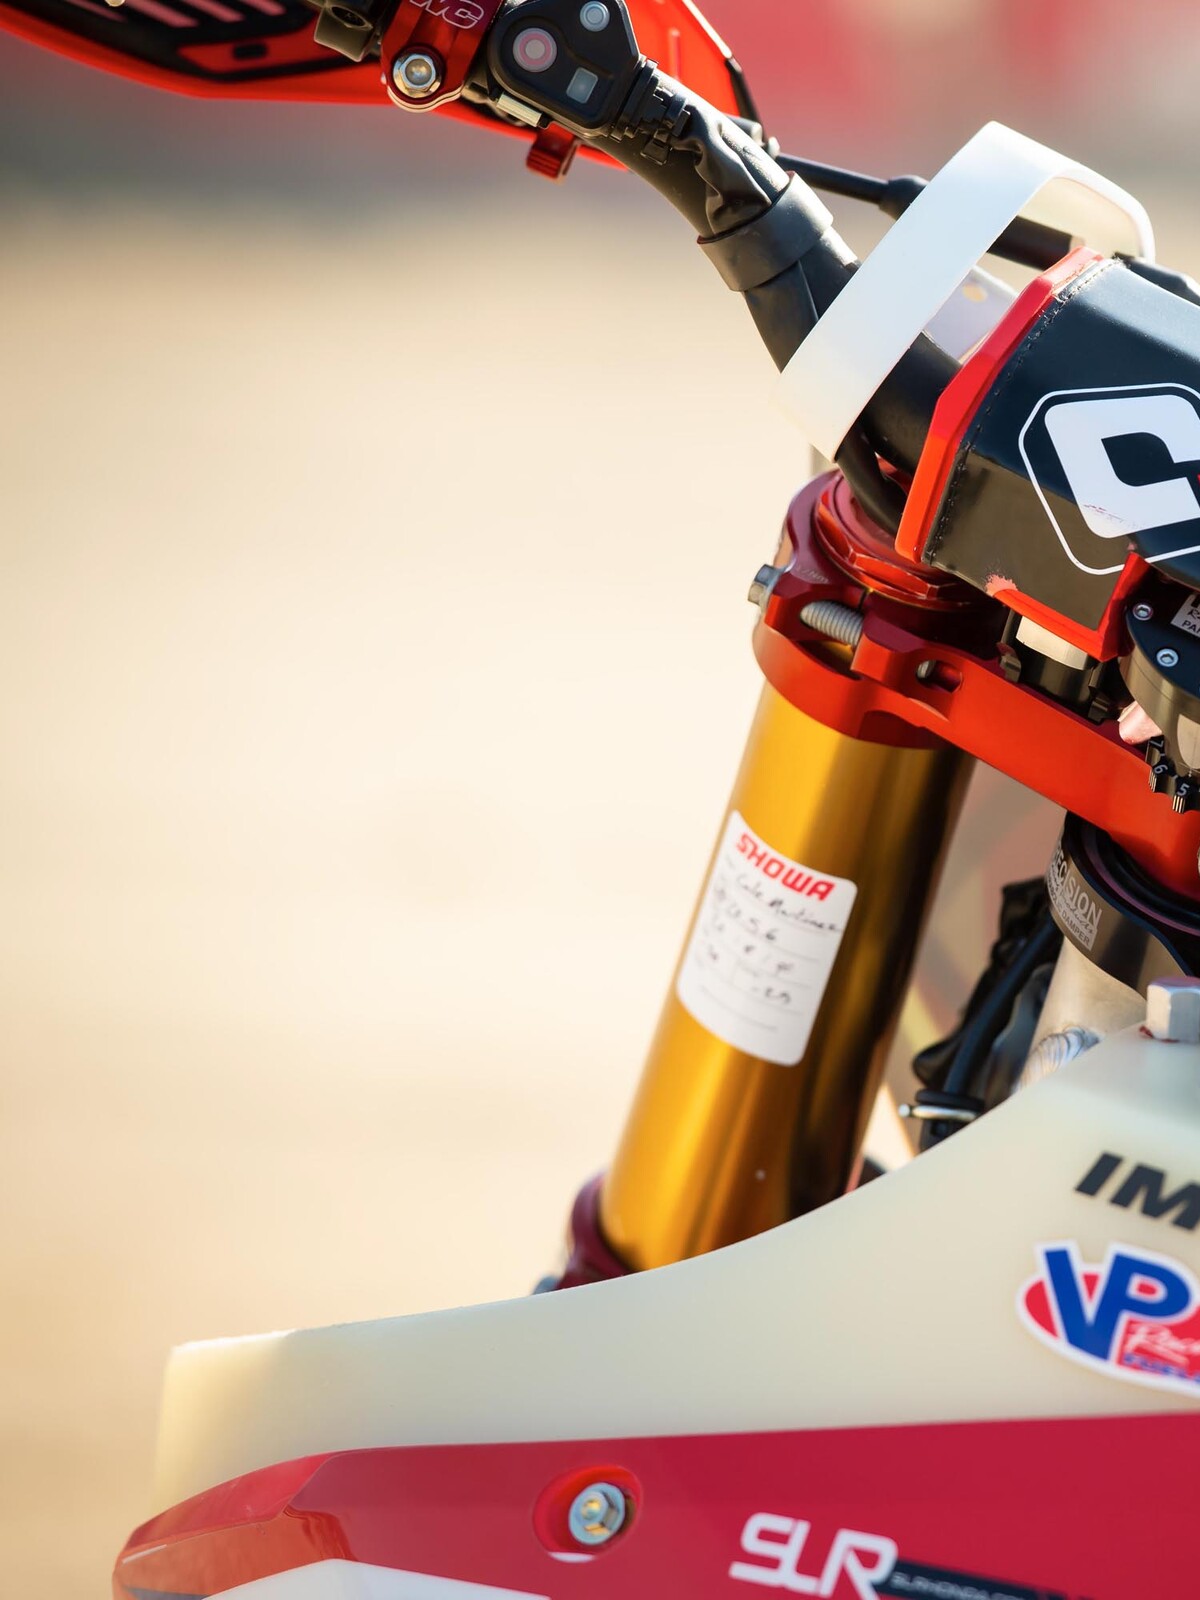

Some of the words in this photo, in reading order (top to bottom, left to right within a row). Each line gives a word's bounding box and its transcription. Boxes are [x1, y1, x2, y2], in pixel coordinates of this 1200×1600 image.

[1153, 763, 1169, 775] 6
[1177, 783, 1191, 797] 5
[736, 832, 836, 901] SHOWA
[1043, 1247, 1191, 1361] VP
[728, 1512, 899, 1600] SLR
